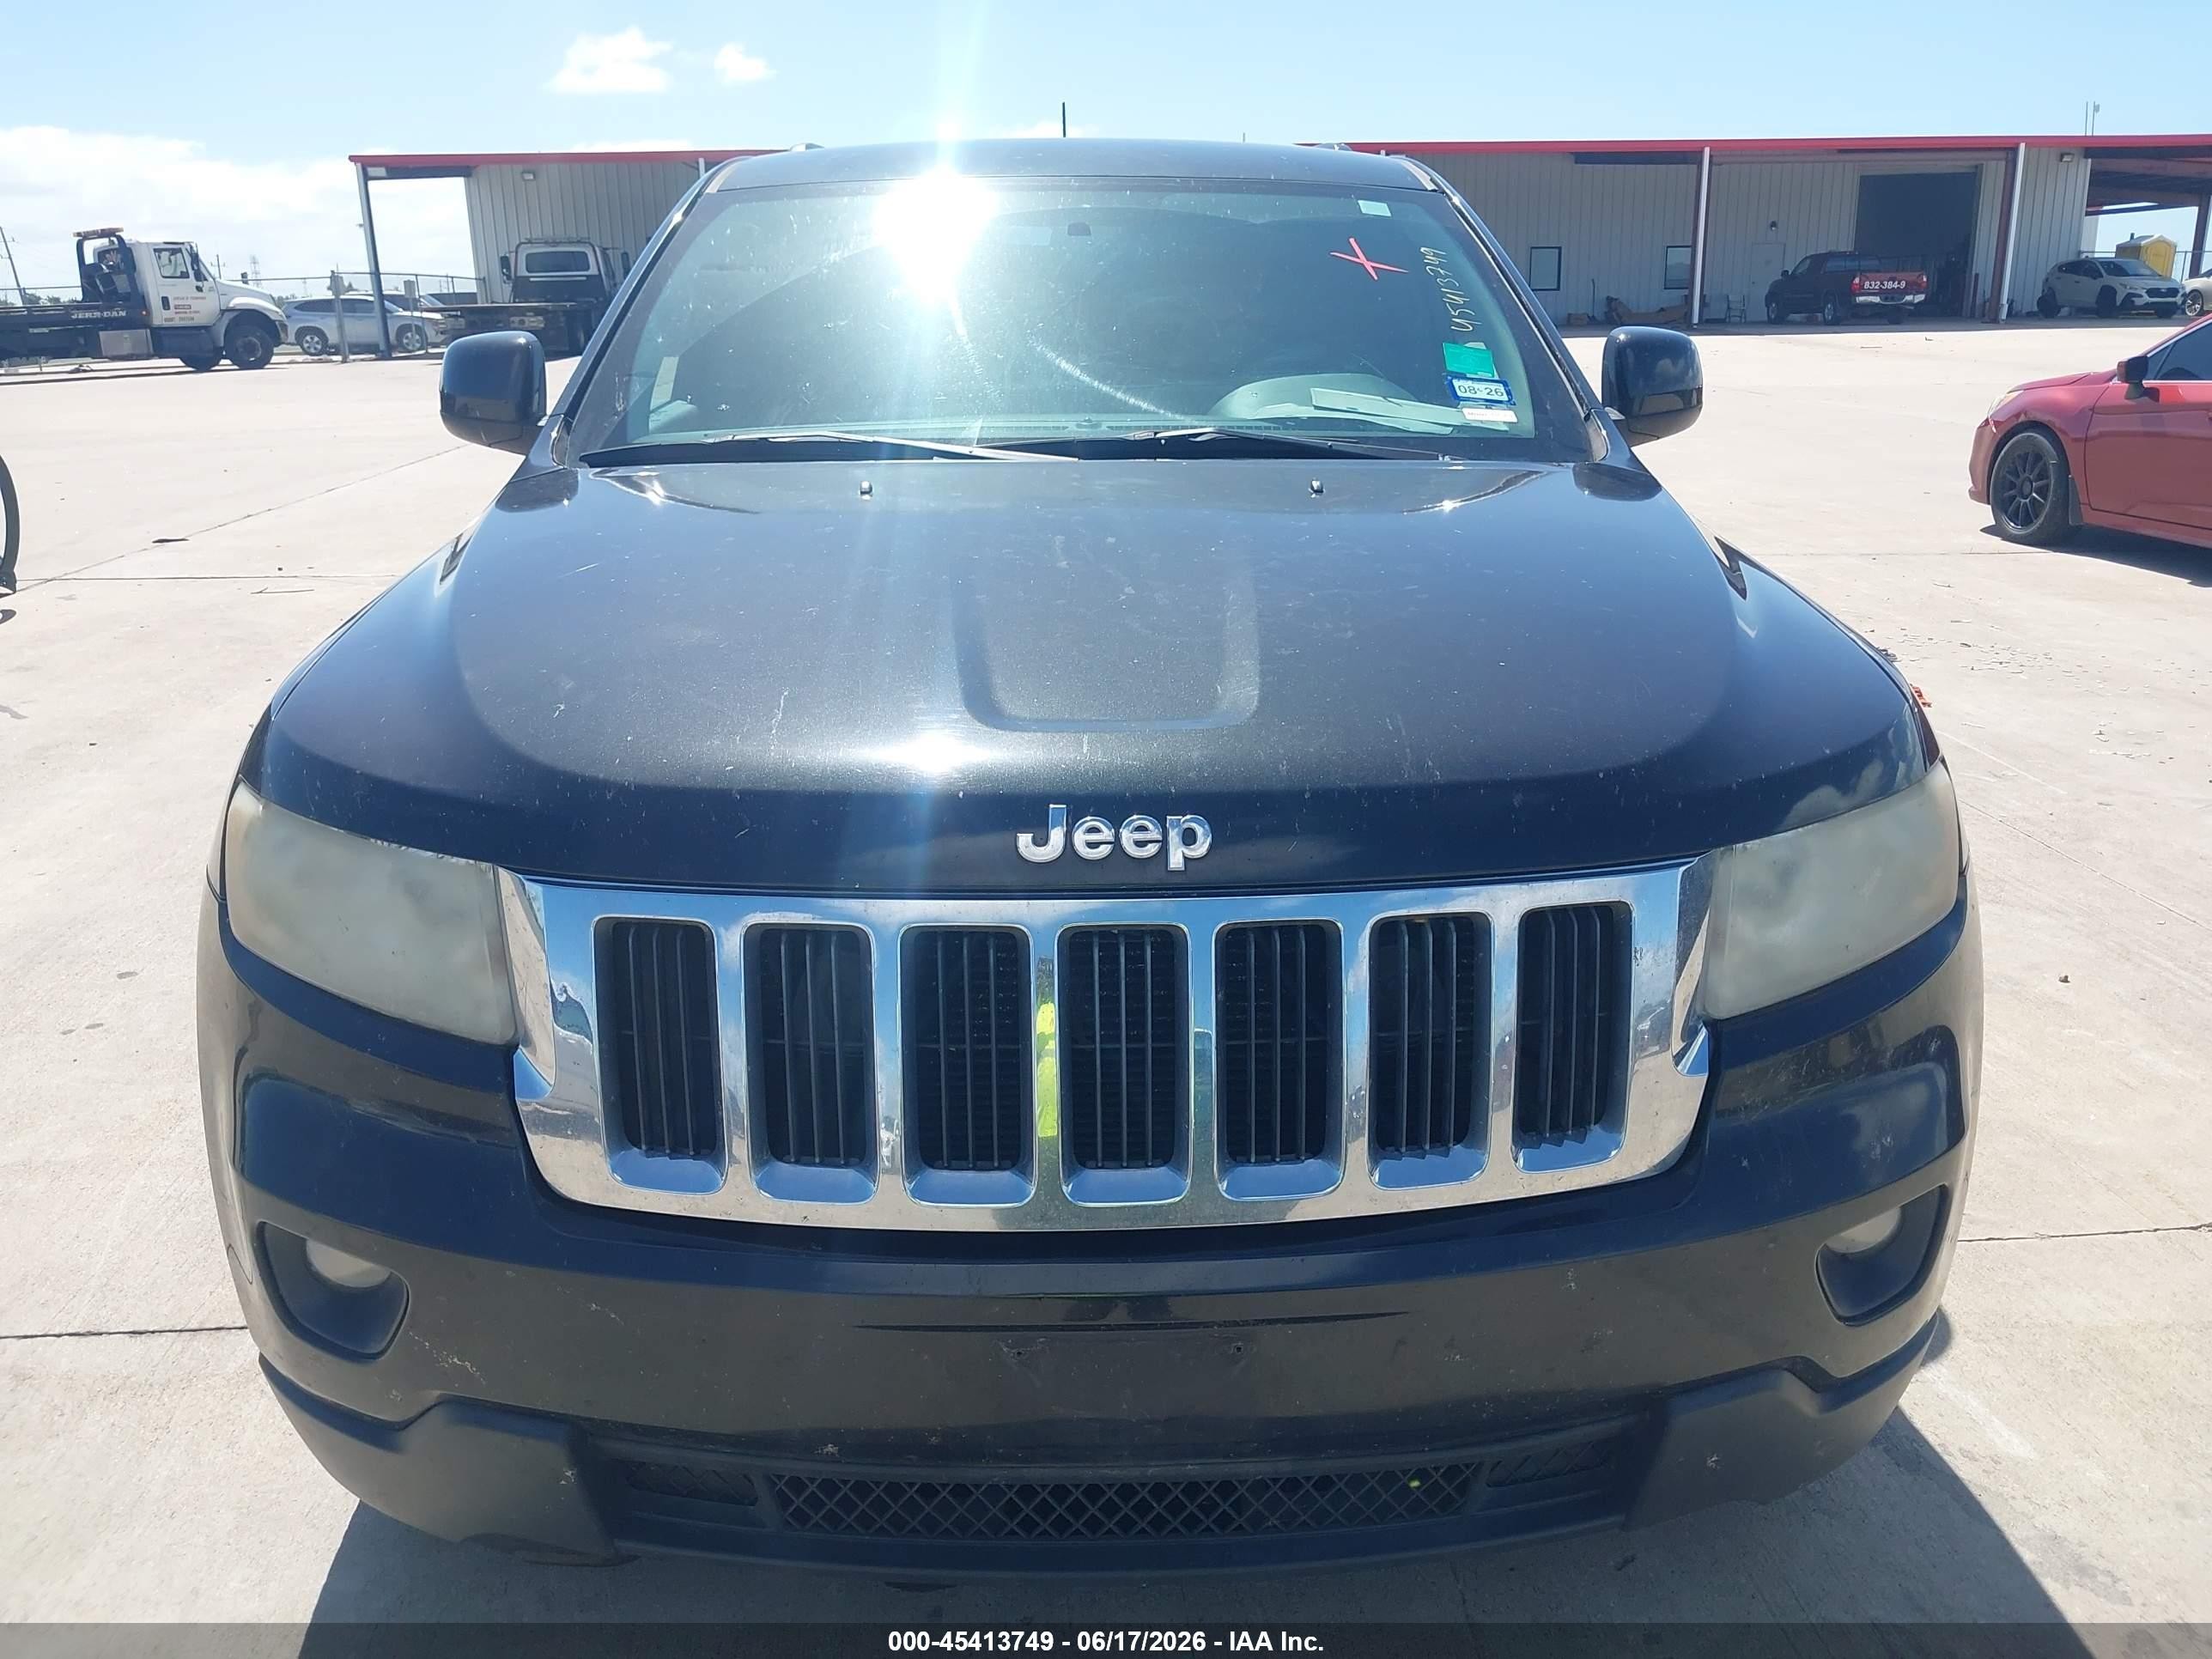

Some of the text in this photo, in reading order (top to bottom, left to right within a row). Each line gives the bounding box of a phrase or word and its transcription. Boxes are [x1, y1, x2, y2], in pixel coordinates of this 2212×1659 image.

[1419, 246, 1482, 331] 45413749
[1863, 280, 1906, 289] 832-384-9
[1016, 804, 1212, 871] Jeep
